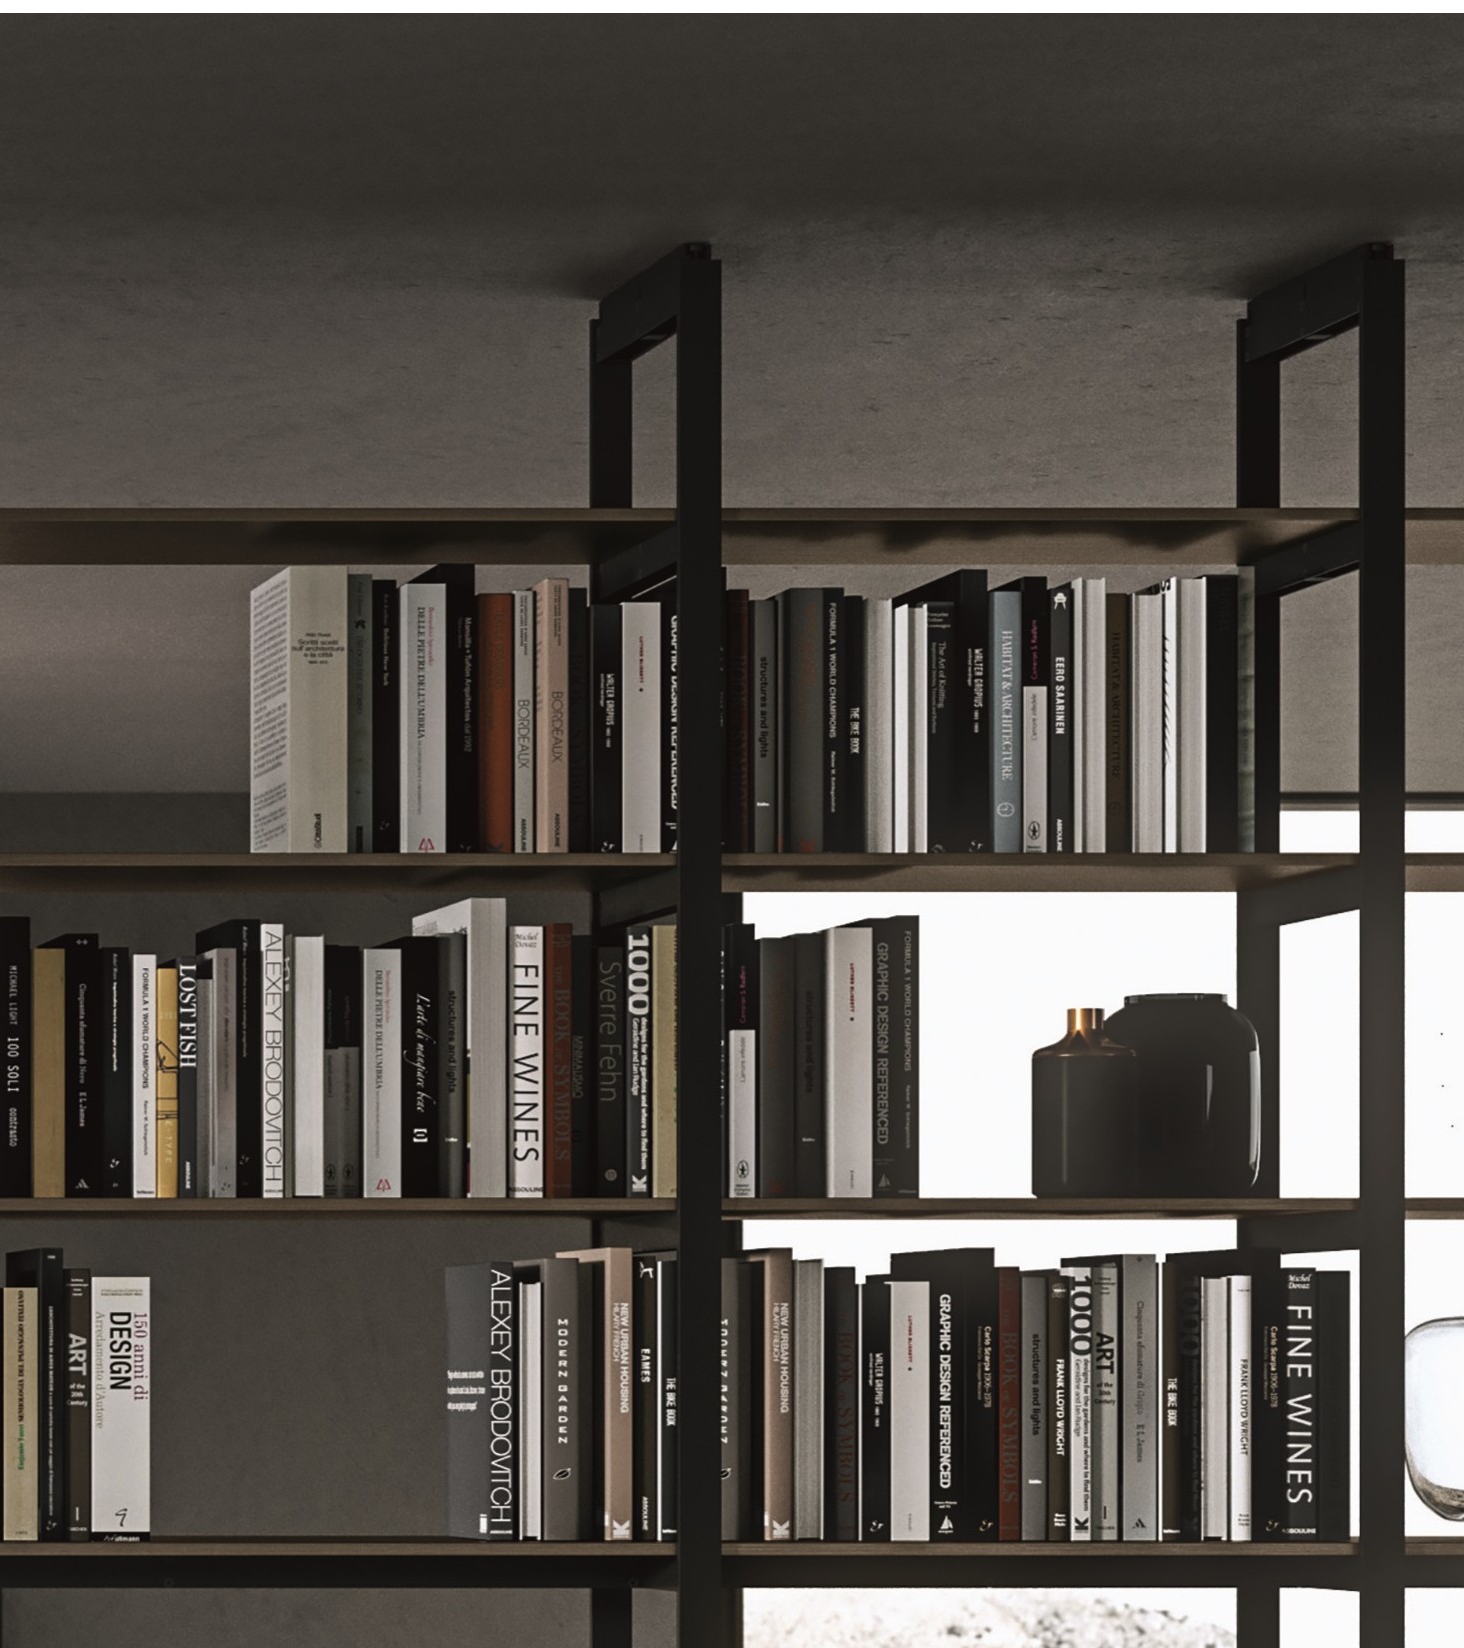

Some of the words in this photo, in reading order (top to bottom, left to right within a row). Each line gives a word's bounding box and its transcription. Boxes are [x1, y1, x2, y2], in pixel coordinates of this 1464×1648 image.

[417, 607, 425, 638] DELLE
[464, 617, 472, 648] Mansilla
[417, 639, 425, 673] PIETRE
[464, 654, 472, 676] Tuñón
[973, 648, 983, 676] WALTER
[1055, 657, 1064, 681] EERO
[464, 678, 472, 721] Arquitectos
[973, 678, 983, 707] GROPIUS
[850, 707, 859, 719] THE
[1055, 685, 1064, 734] SAARINEN
[464, 723, 472, 733] dal
[518, 699, 530, 769] BORDEAUX
[850, 722, 859, 736] BIKE
[464, 735, 472, 752] 1992
[850, 738, 859, 754] BOOK
[628, 933, 649, 1015] 1000
[179, 964, 197, 1017] LOST
[599, 961, 622, 1035] Sverre
[639, 1017, 649, 1042] designs
[179, 1022, 197, 1068] FISH
[639, 1043, 649, 1054] for
[599, 1044, 622, 1101] Fehn
[639, 1055, 649, 1066] the
[639, 1067, 649, 1092] gardens
[639, 1094, 649, 1107] and
[639, 1108, 649, 1128] where
[639, 1138, 649, 1151] find
[639, 1153, 649, 1170] them
[134, 1312, 148, 1339] 150
[491, 1269, 511, 1361] ALEXEY
[110, 1312, 132, 1390] DESIGN
[558, 1320, 568, 1377] MODERN
[1286, 1305, 1313, 1379] FINE
[134, 1344, 148, 1381] anni
[134, 1385, 148, 1401] di
[558, 1385, 568, 1444] GARDEN
[491, 1369, 511, 1522] BRODOVITCH
[1286, 1393, 1313, 1504] WINES
